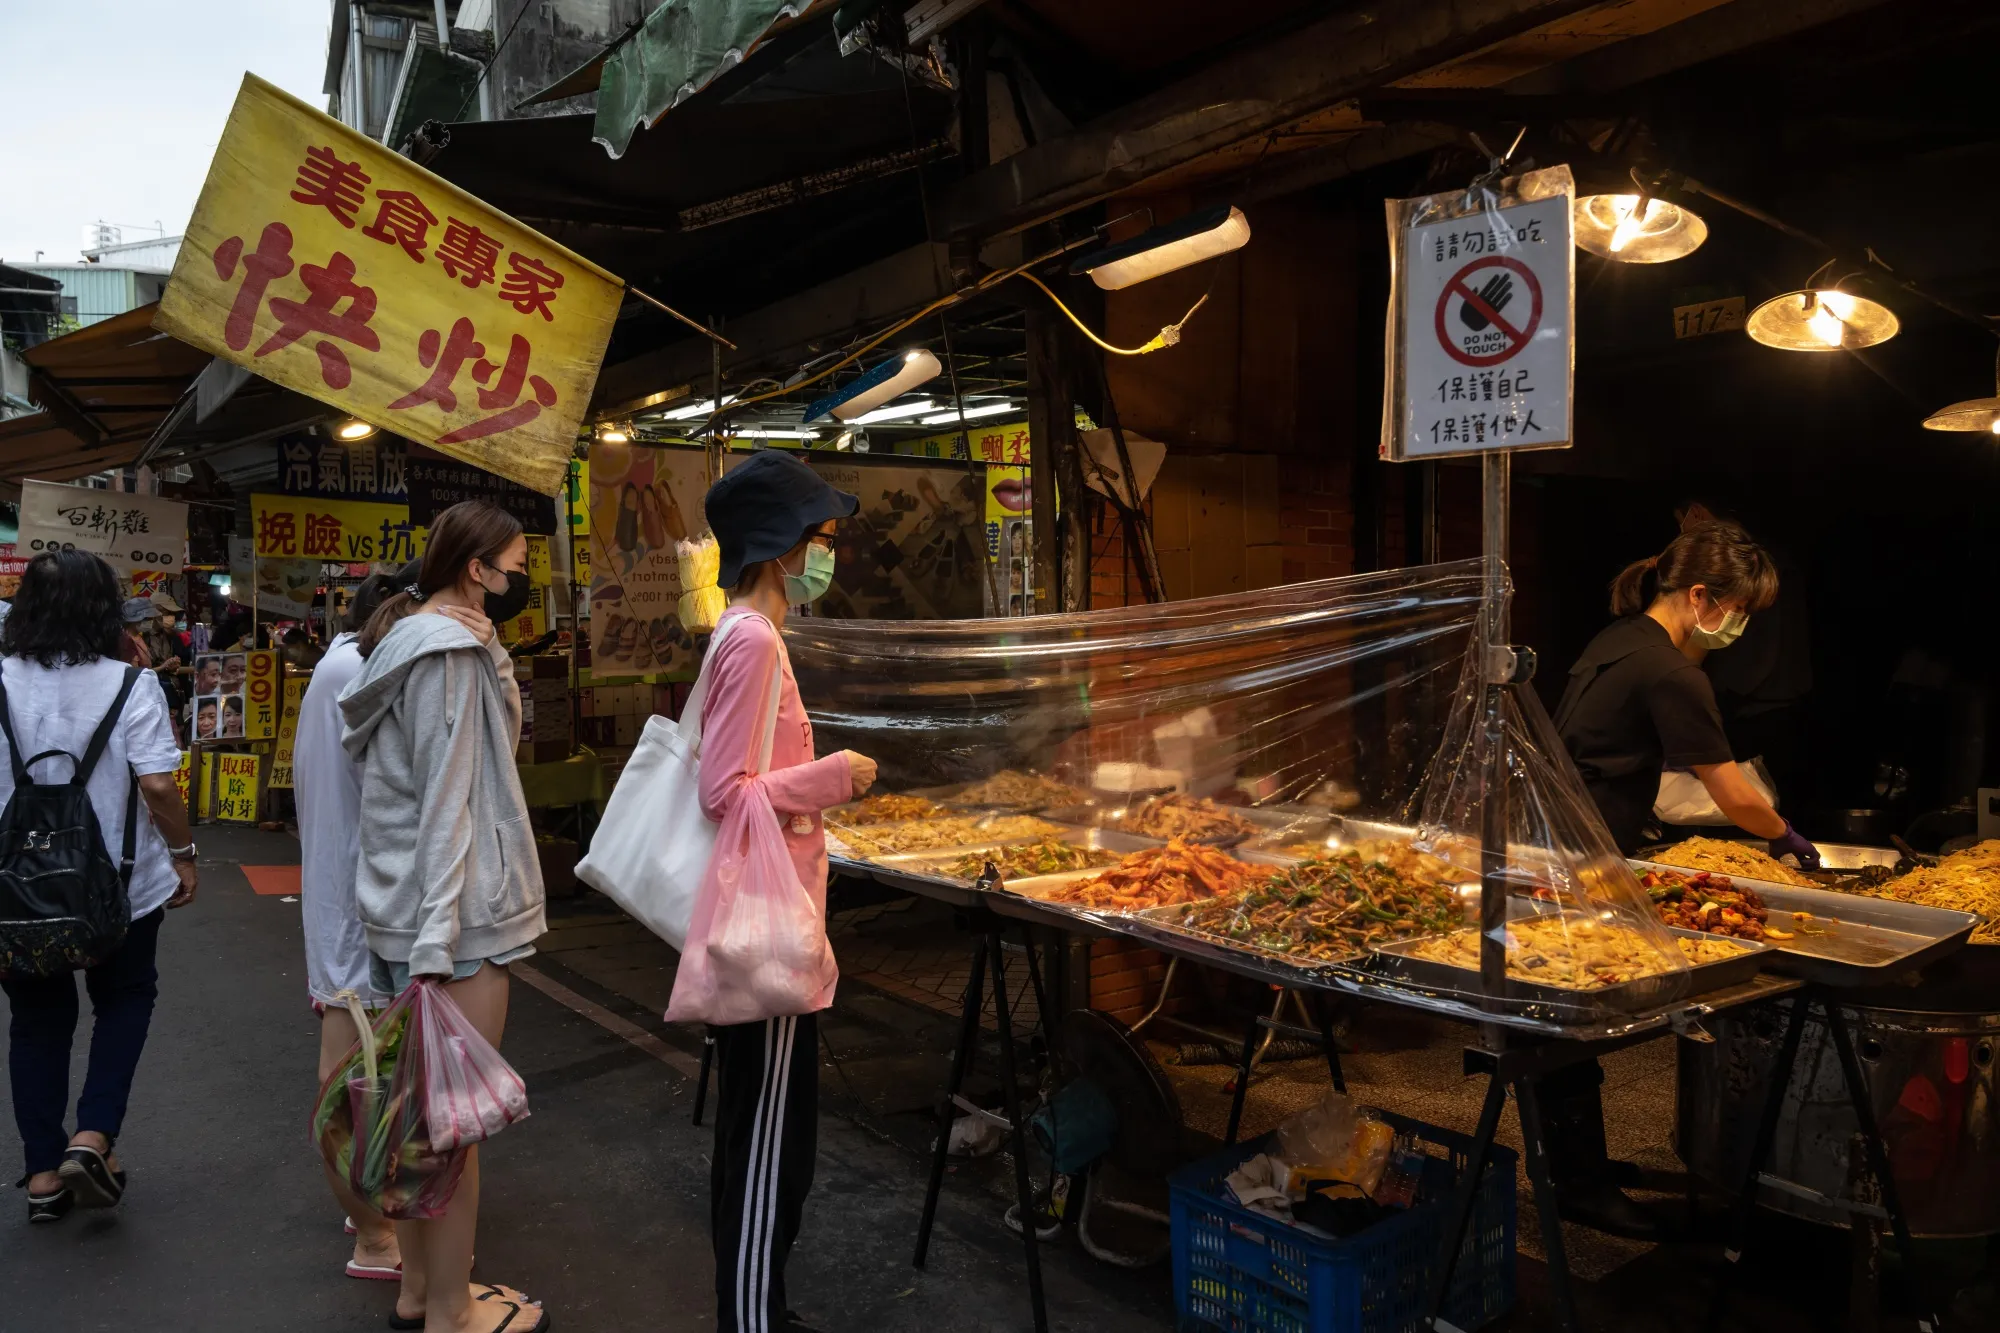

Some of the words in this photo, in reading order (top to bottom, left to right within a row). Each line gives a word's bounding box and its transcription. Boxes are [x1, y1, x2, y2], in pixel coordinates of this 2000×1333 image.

[290, 146, 565, 322] 美食專家
[1436, 219, 1544, 262] 請勿試吃
[213, 222, 558, 443] 快炒
[1464, 334, 1484, 345] DO
[1485, 331, 1507, 343] NOT
[1466, 342, 1506, 356] TOUCH
[1438, 370, 1535, 403] 保護自己
[1431, 410, 1541, 444] 保護他人
[283, 442, 408, 494] 冷氣開放
[222, 757, 256, 778] 取斑
[228, 778, 246, 796] 除
[218, 798, 254, 818] 肉芽
